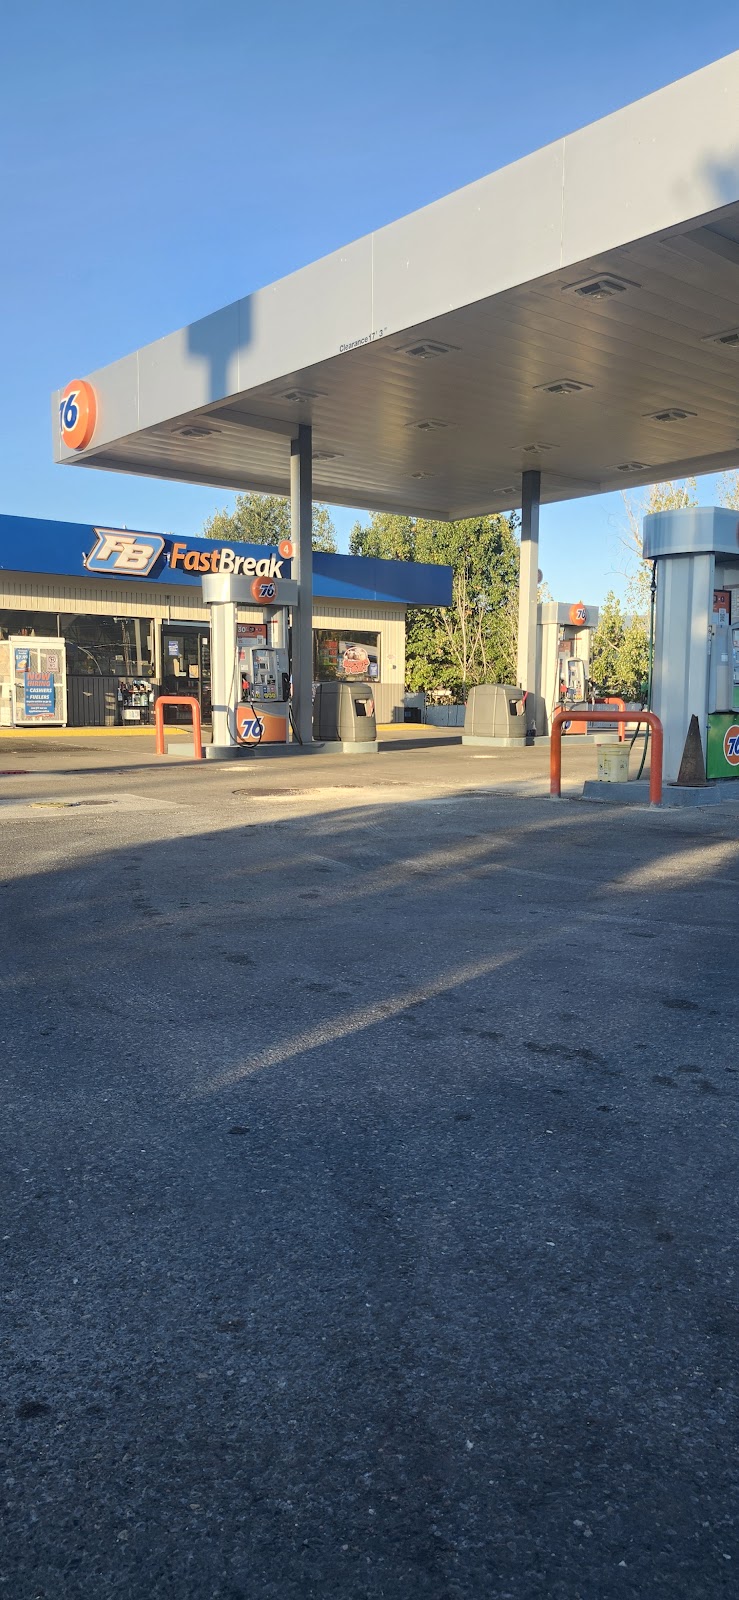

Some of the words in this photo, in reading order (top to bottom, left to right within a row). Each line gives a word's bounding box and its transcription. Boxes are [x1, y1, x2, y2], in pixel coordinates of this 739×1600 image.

[340, 336, 368, 352] Clearance
[96, 534, 155, 570] FB
[170, 542, 284, 579] FastBreak
[258, 583, 276, 598] 76
[240, 716, 265, 739] 76
